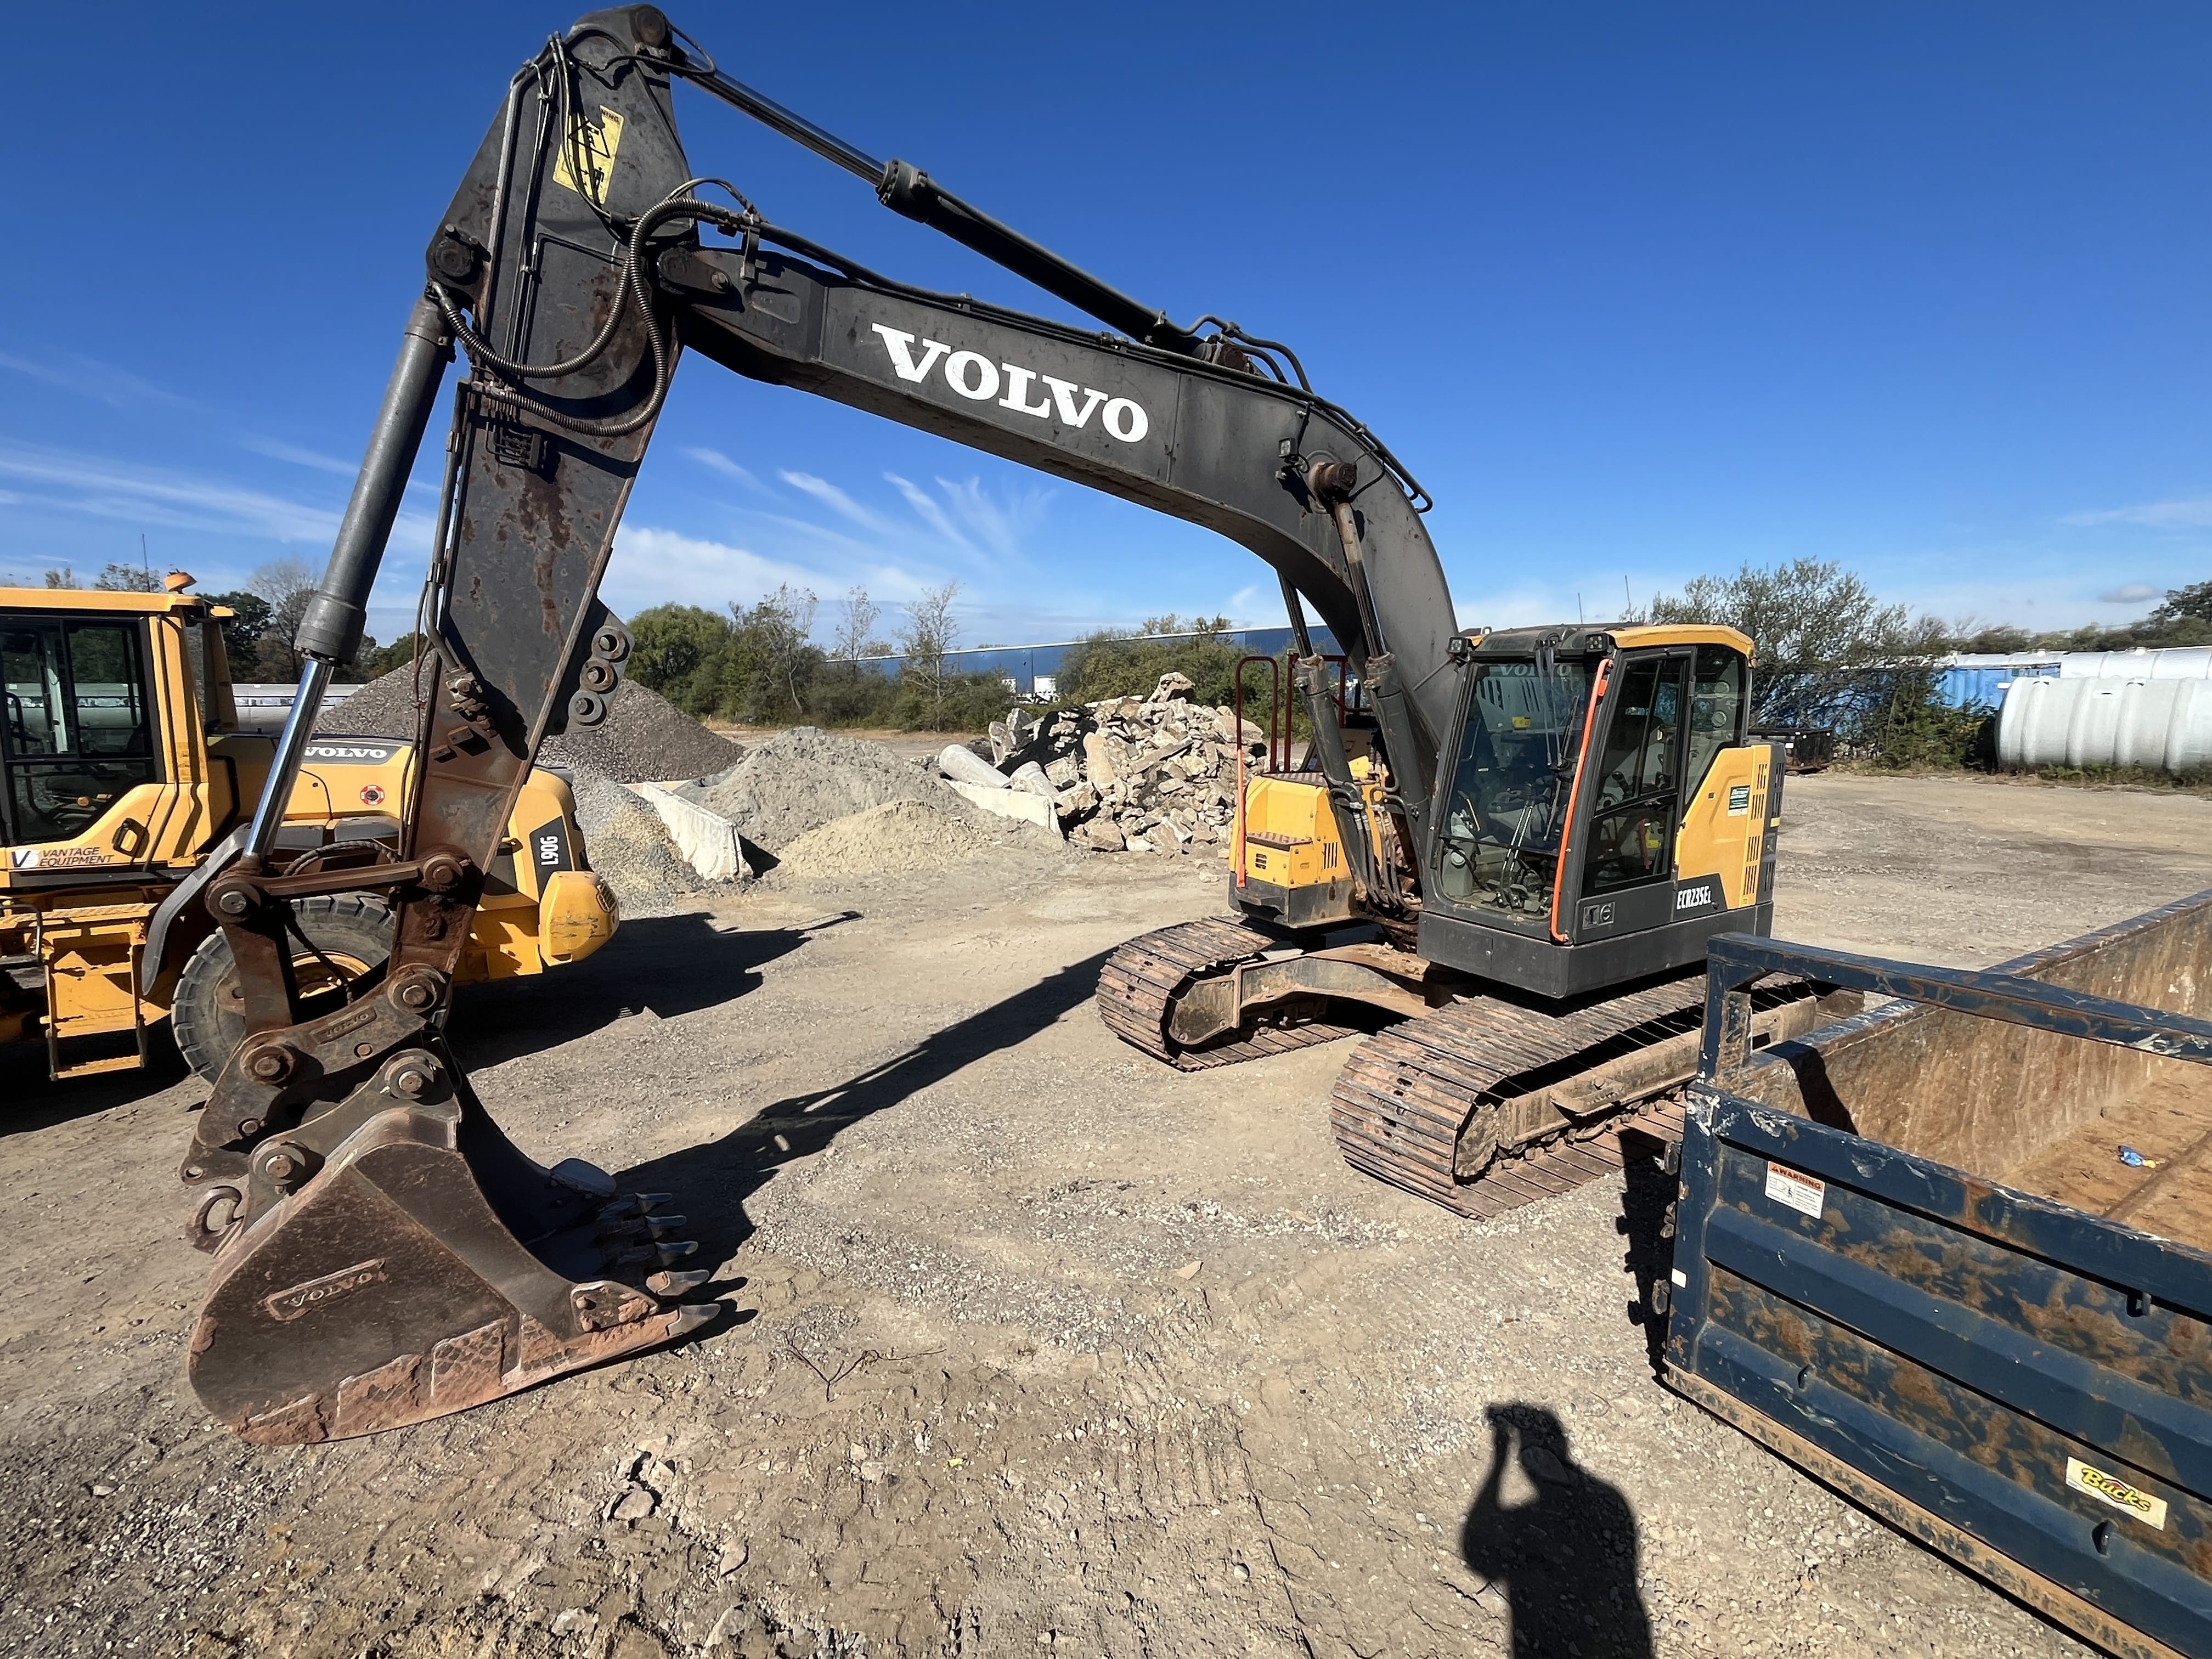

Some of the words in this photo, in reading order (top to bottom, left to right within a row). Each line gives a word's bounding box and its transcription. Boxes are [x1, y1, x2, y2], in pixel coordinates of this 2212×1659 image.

[871, 322, 1149, 443] VOLVO
[304, 747, 387, 758] VOLVO
[39, 855, 115, 867] EQUIPMENT
[42, 847, 100, 857] VANTAGE
[540, 836, 559, 865] L90G
[1779, 1167, 1821, 1190] WARNING
[2081, 1466, 2151, 1512] Bucks
